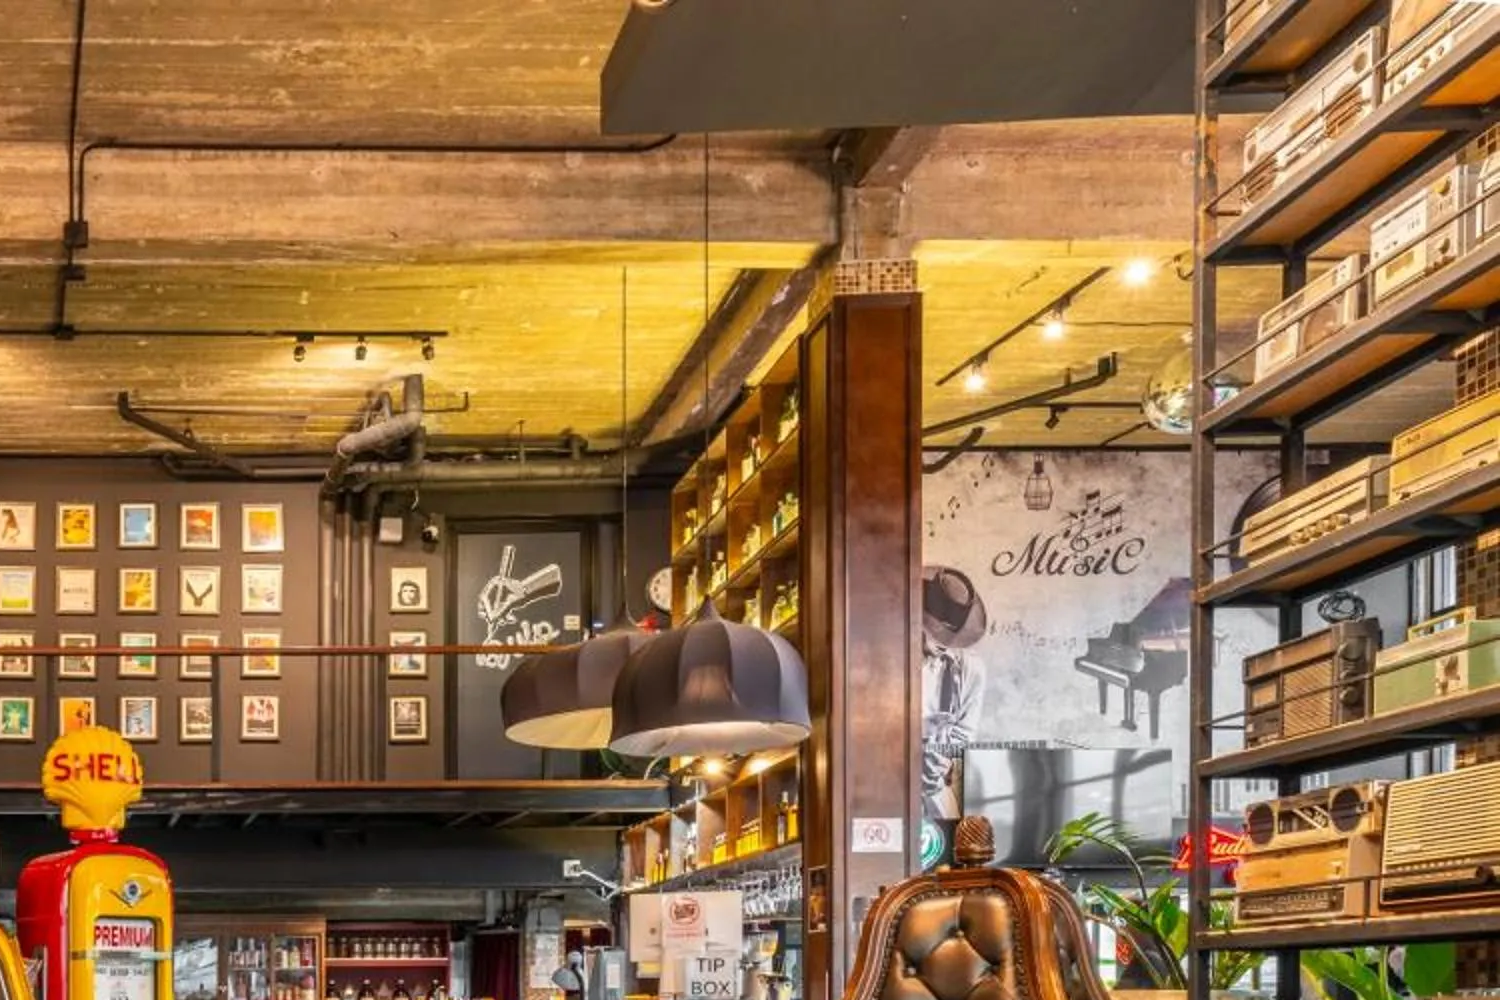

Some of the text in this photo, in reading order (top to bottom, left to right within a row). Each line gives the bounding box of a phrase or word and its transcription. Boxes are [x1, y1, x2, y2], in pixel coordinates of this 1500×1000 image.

[53, 753, 141, 785] SHELL
[94, 924, 153, 948] PREMIUM
[696, 957, 726, 973] TIP
[691, 981, 731, 995] BOX
